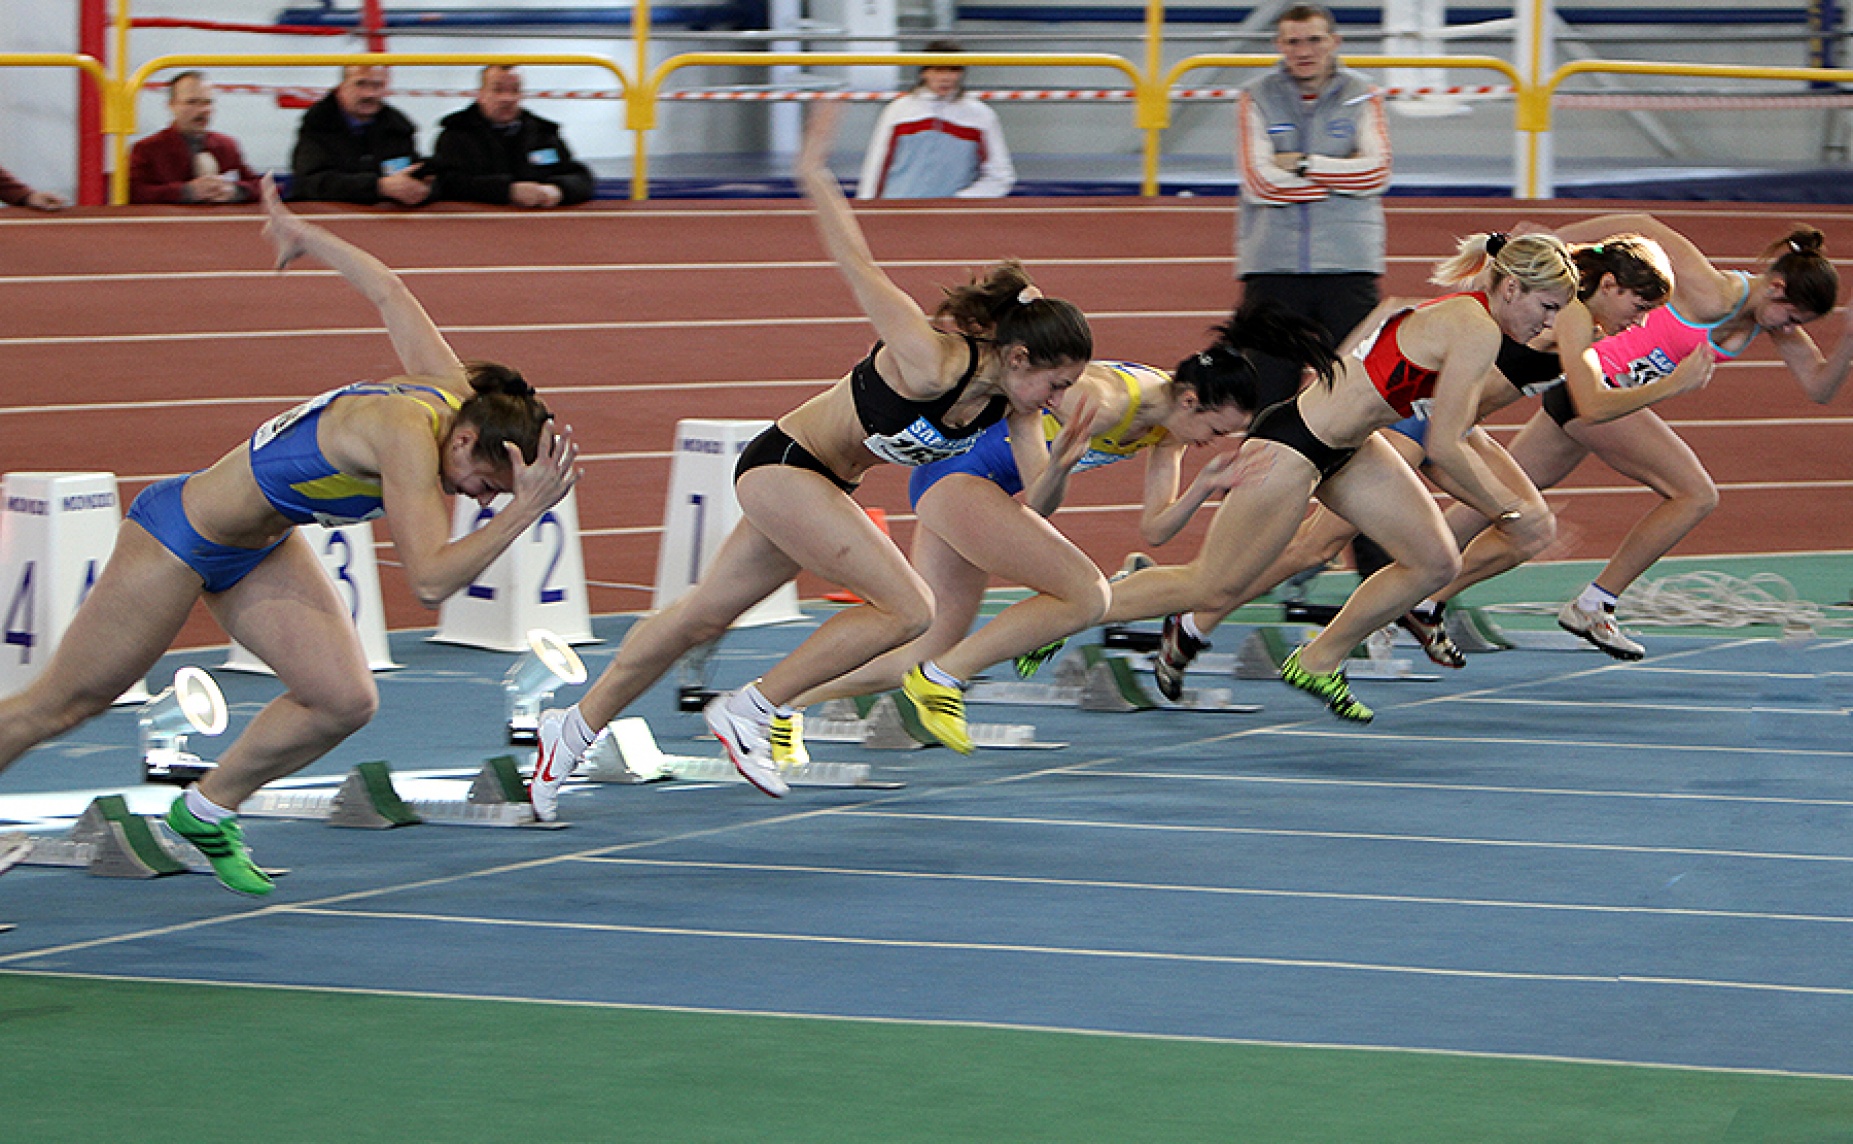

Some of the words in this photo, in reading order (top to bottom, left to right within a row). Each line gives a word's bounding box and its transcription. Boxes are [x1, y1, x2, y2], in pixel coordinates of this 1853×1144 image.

[325, 530, 360, 626] 3
[533, 510, 567, 604] 2
[688, 494, 706, 585] 1
[4, 559, 36, 665] 4
